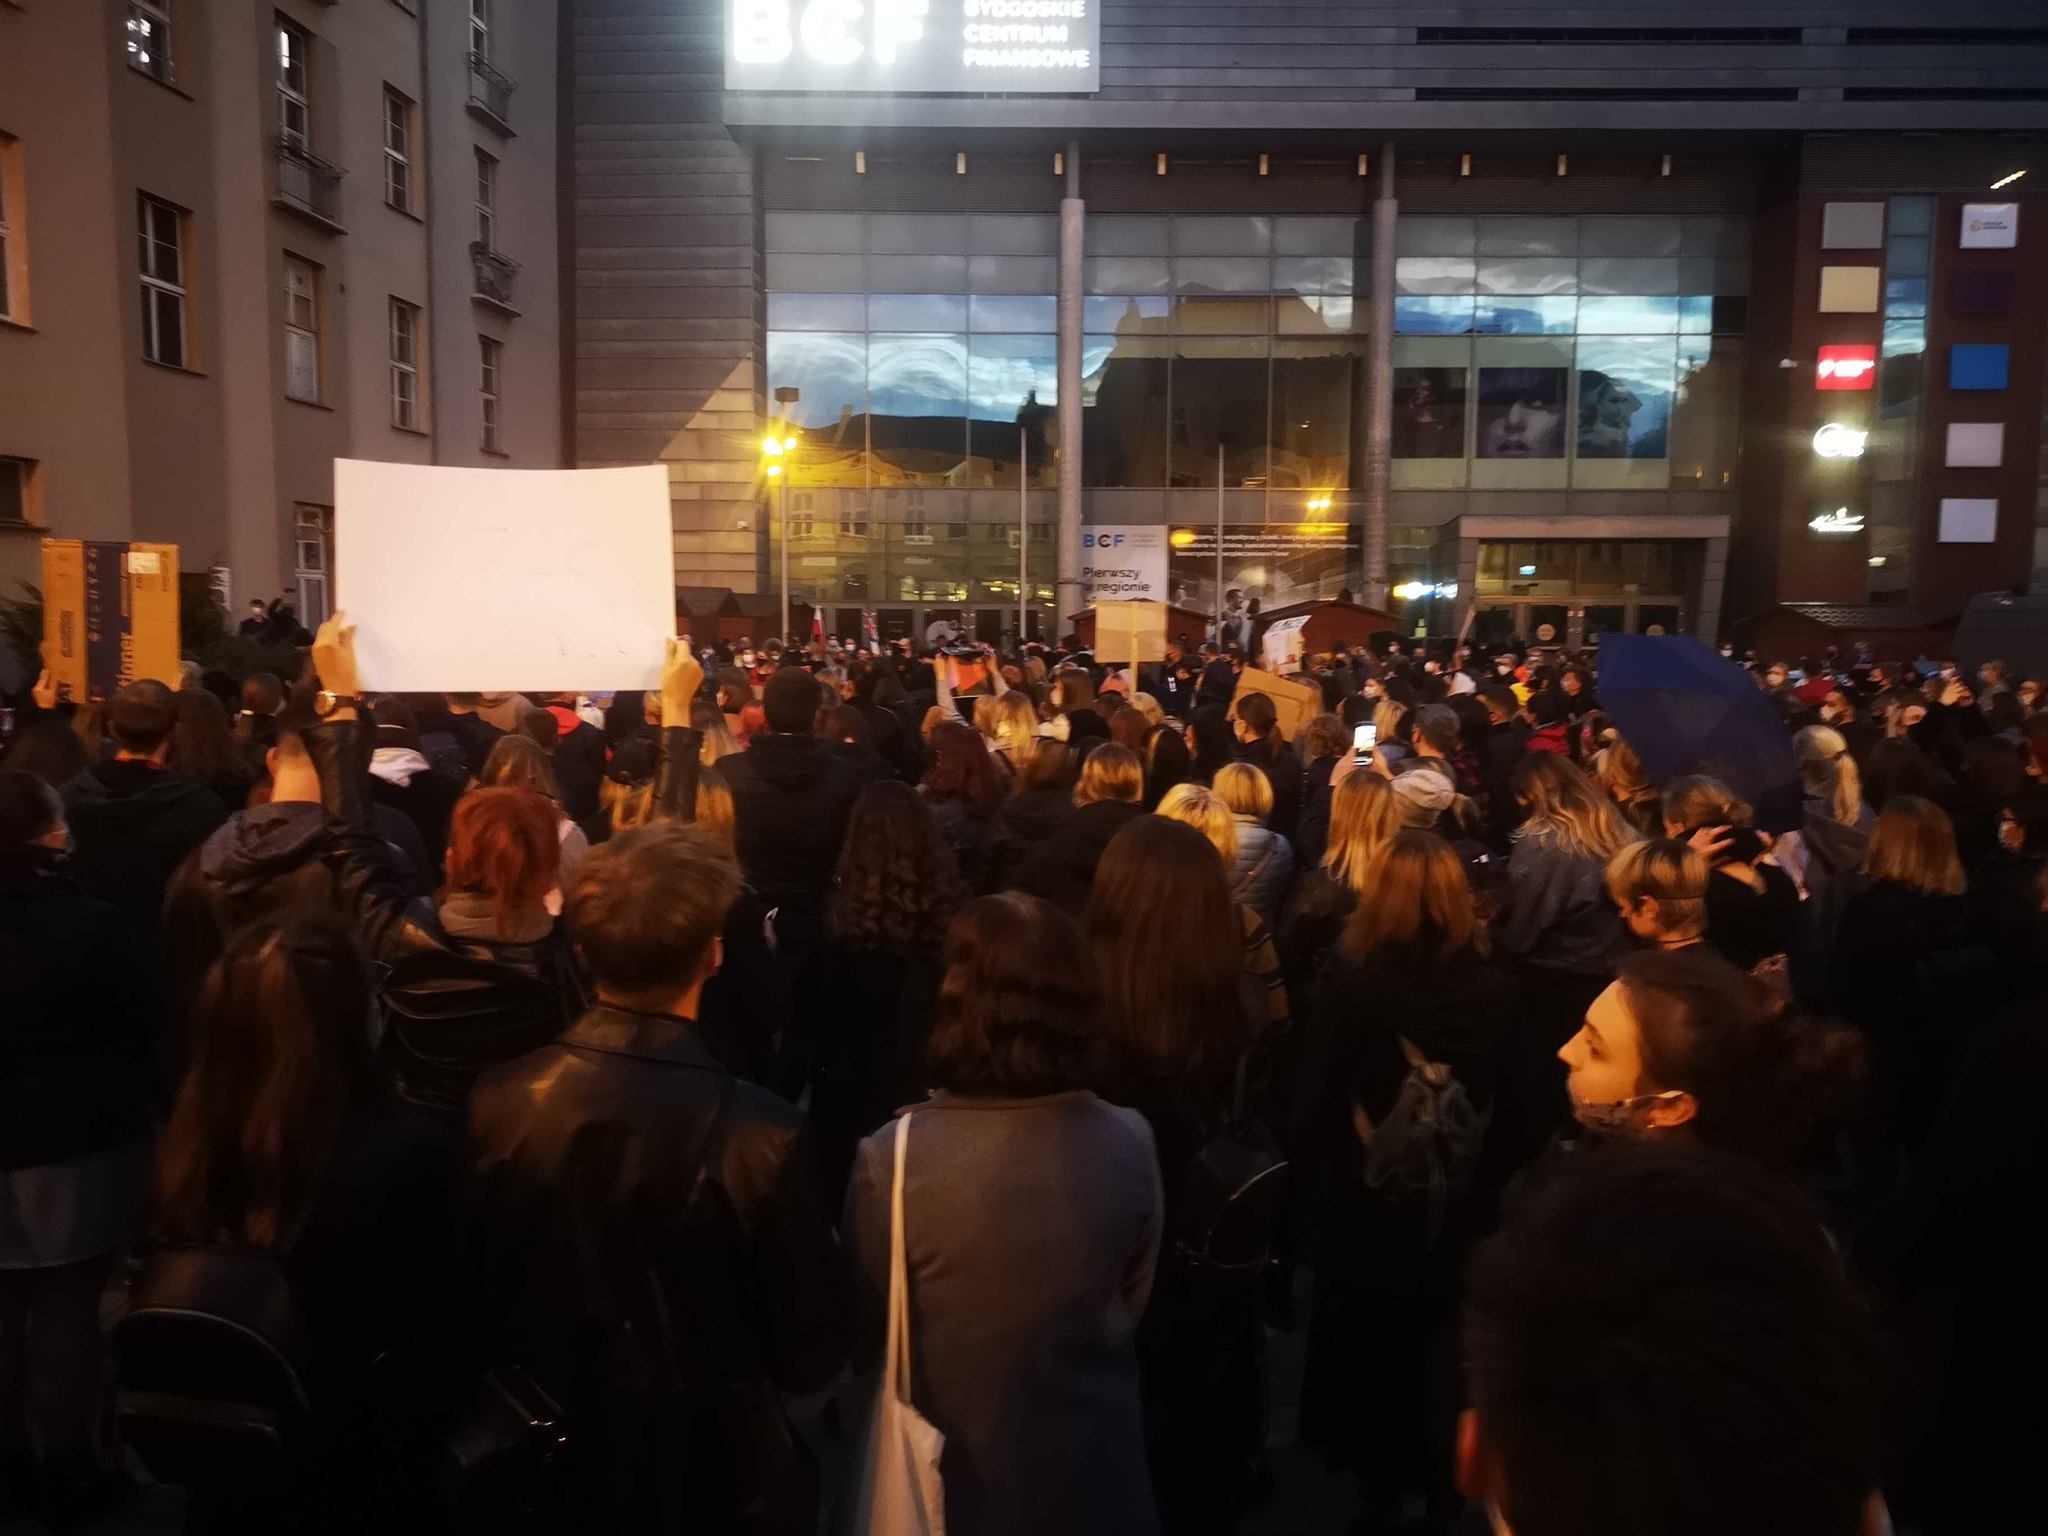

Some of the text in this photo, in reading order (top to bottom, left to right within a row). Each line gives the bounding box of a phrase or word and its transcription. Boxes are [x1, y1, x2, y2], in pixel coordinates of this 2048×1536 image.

[964, 0, 1086, 18] BYDGOSKIE
[733, 0, 931, 64] BCF
[964, 24, 1069, 43] CENTRUM
[964, 48, 1090, 67] FINANSOWE
[1082, 534, 1125, 548] BCF
[1083, 567, 1142, 581] Pierwszy
[1083, 581, 1151, 594] w regionie
